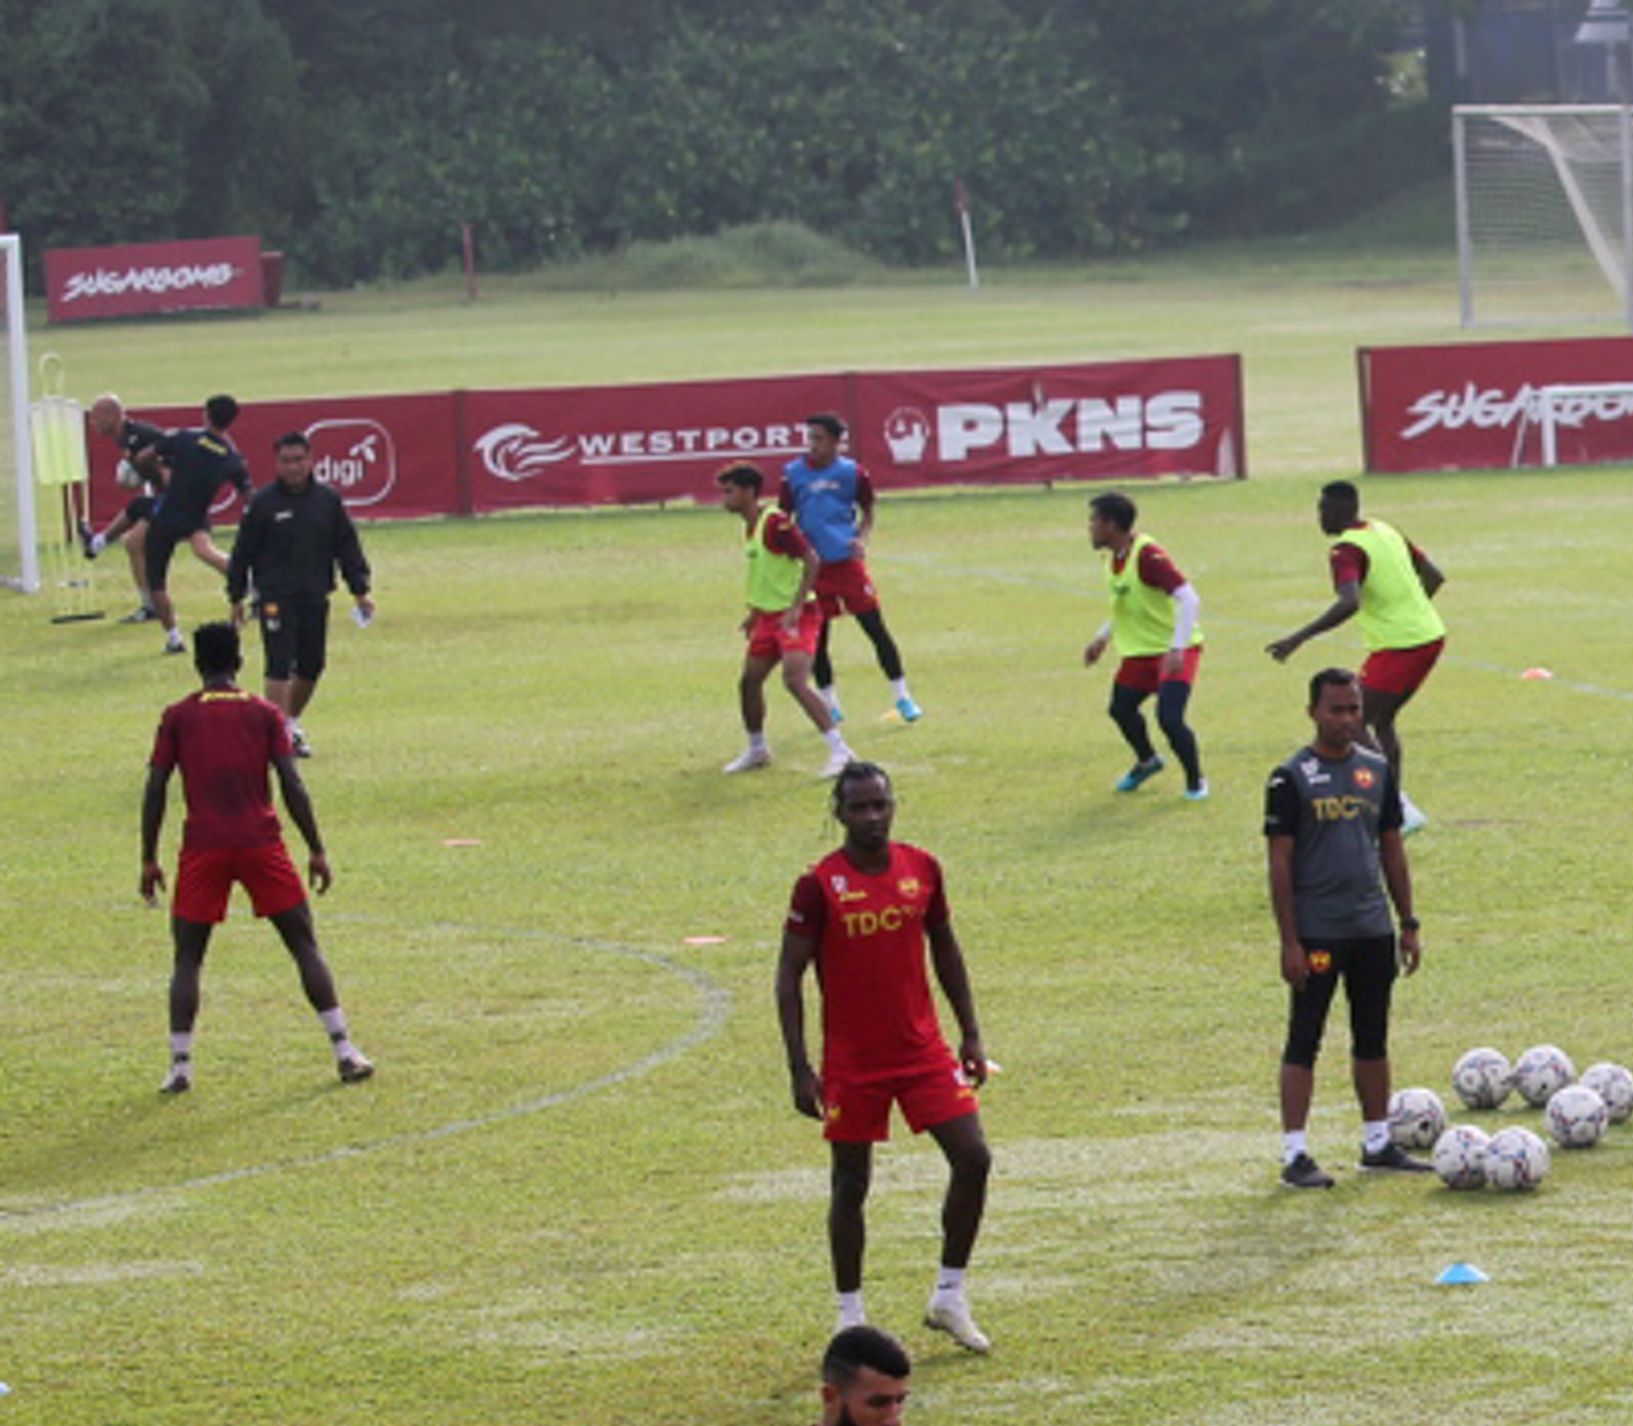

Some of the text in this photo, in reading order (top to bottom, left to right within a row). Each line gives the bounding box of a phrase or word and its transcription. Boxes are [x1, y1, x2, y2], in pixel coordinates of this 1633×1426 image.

[937, 390, 1204, 462] PKNS
[313, 456, 364, 486] digi
[842, 904, 903, 938] TDC
